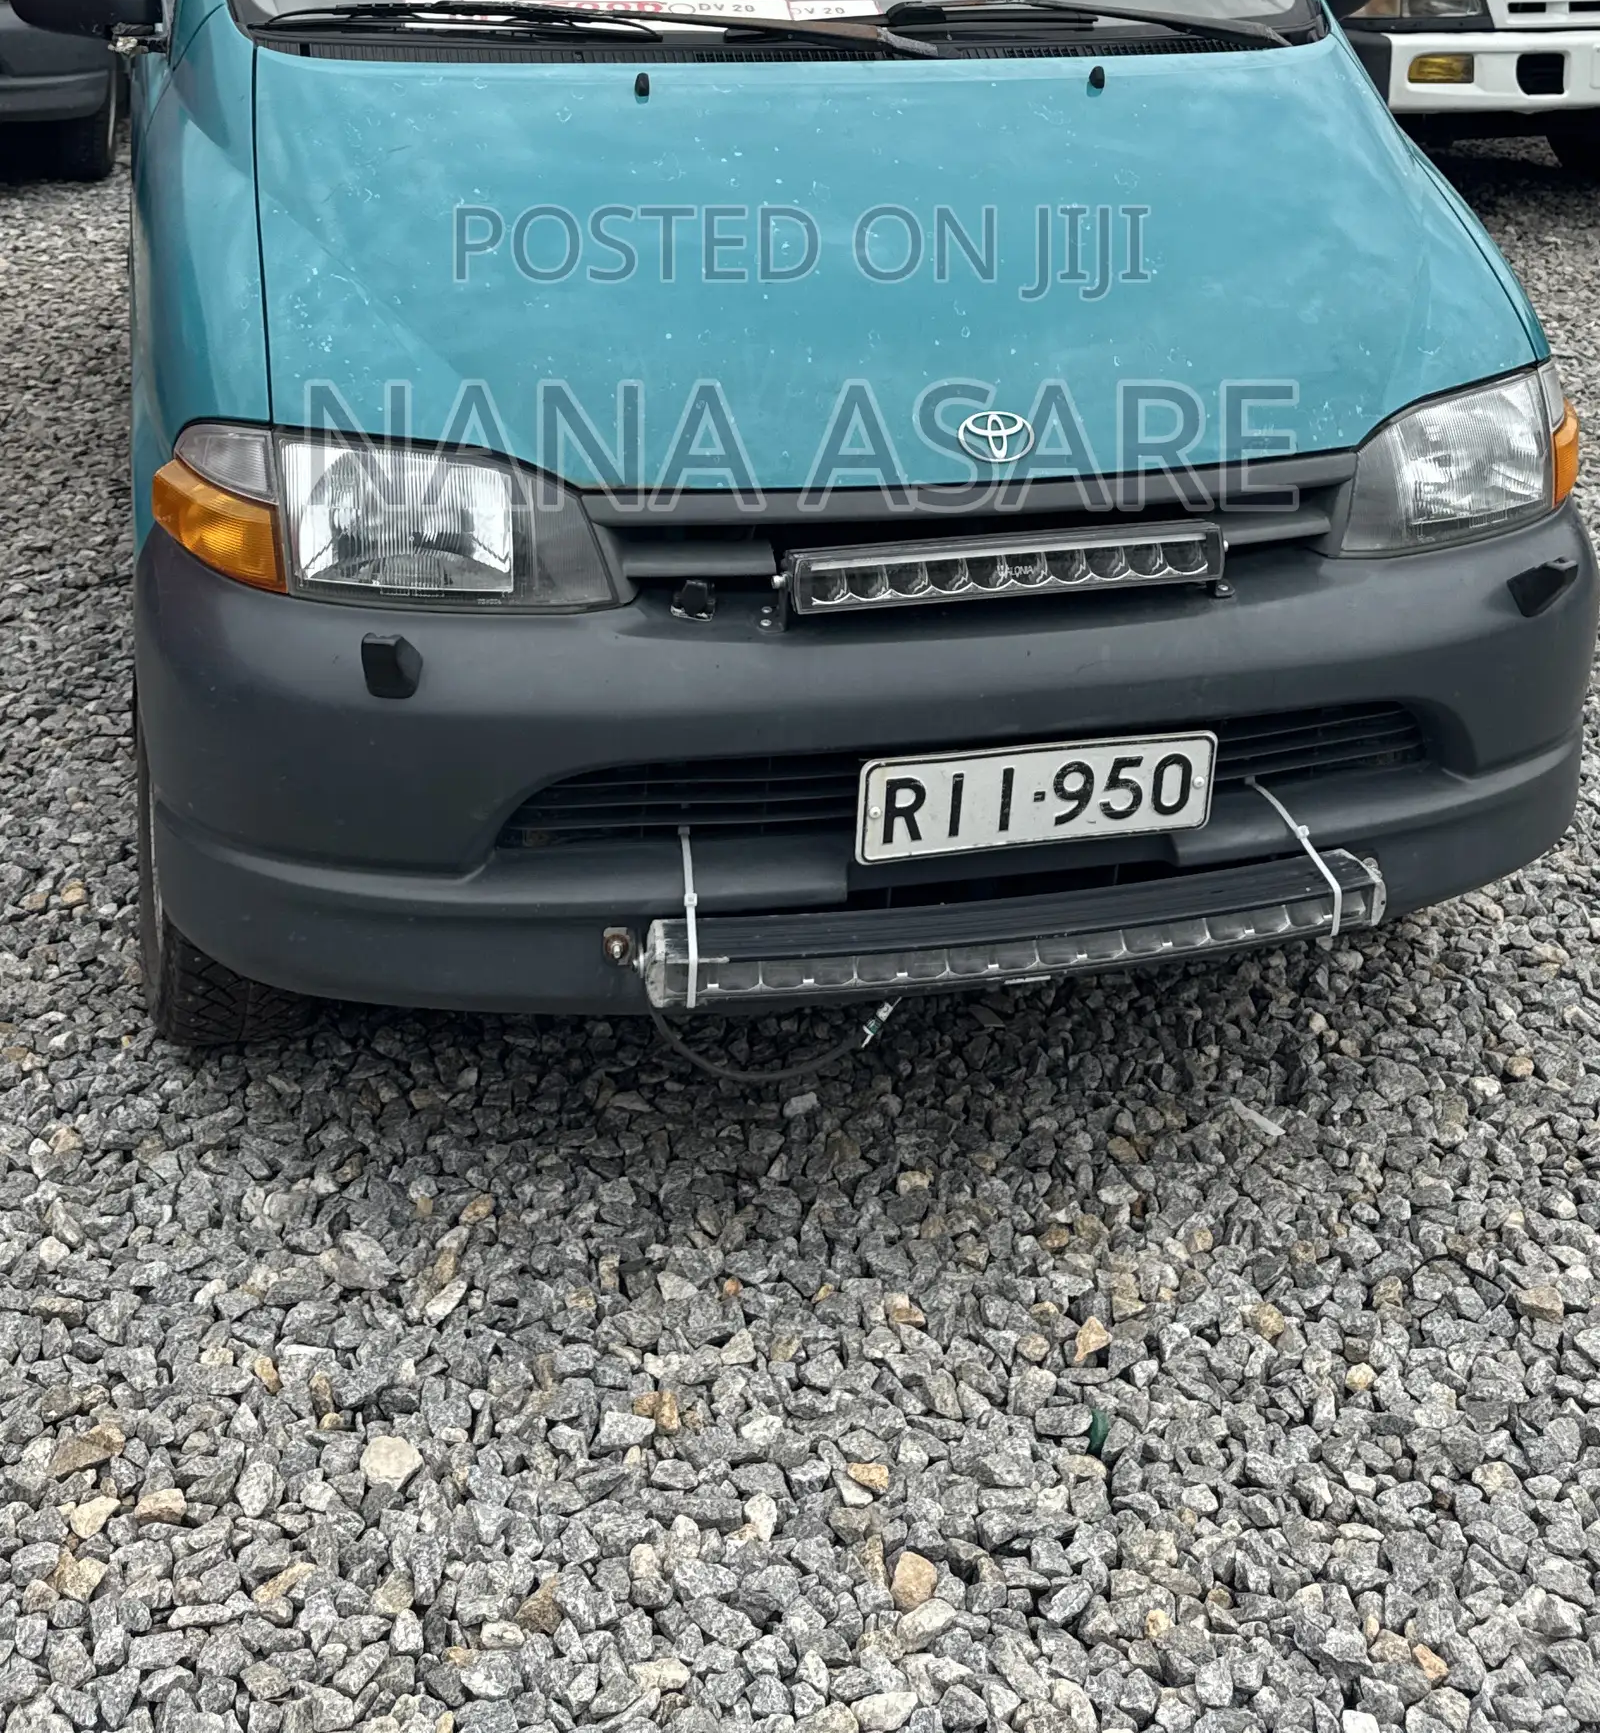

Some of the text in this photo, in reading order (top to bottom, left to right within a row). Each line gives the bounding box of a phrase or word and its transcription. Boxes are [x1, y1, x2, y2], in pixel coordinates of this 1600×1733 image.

[698, 3, 756, 13] DV 20
[823, 7, 846, 15] 20
[882, 752, 1194, 844] RII-950
